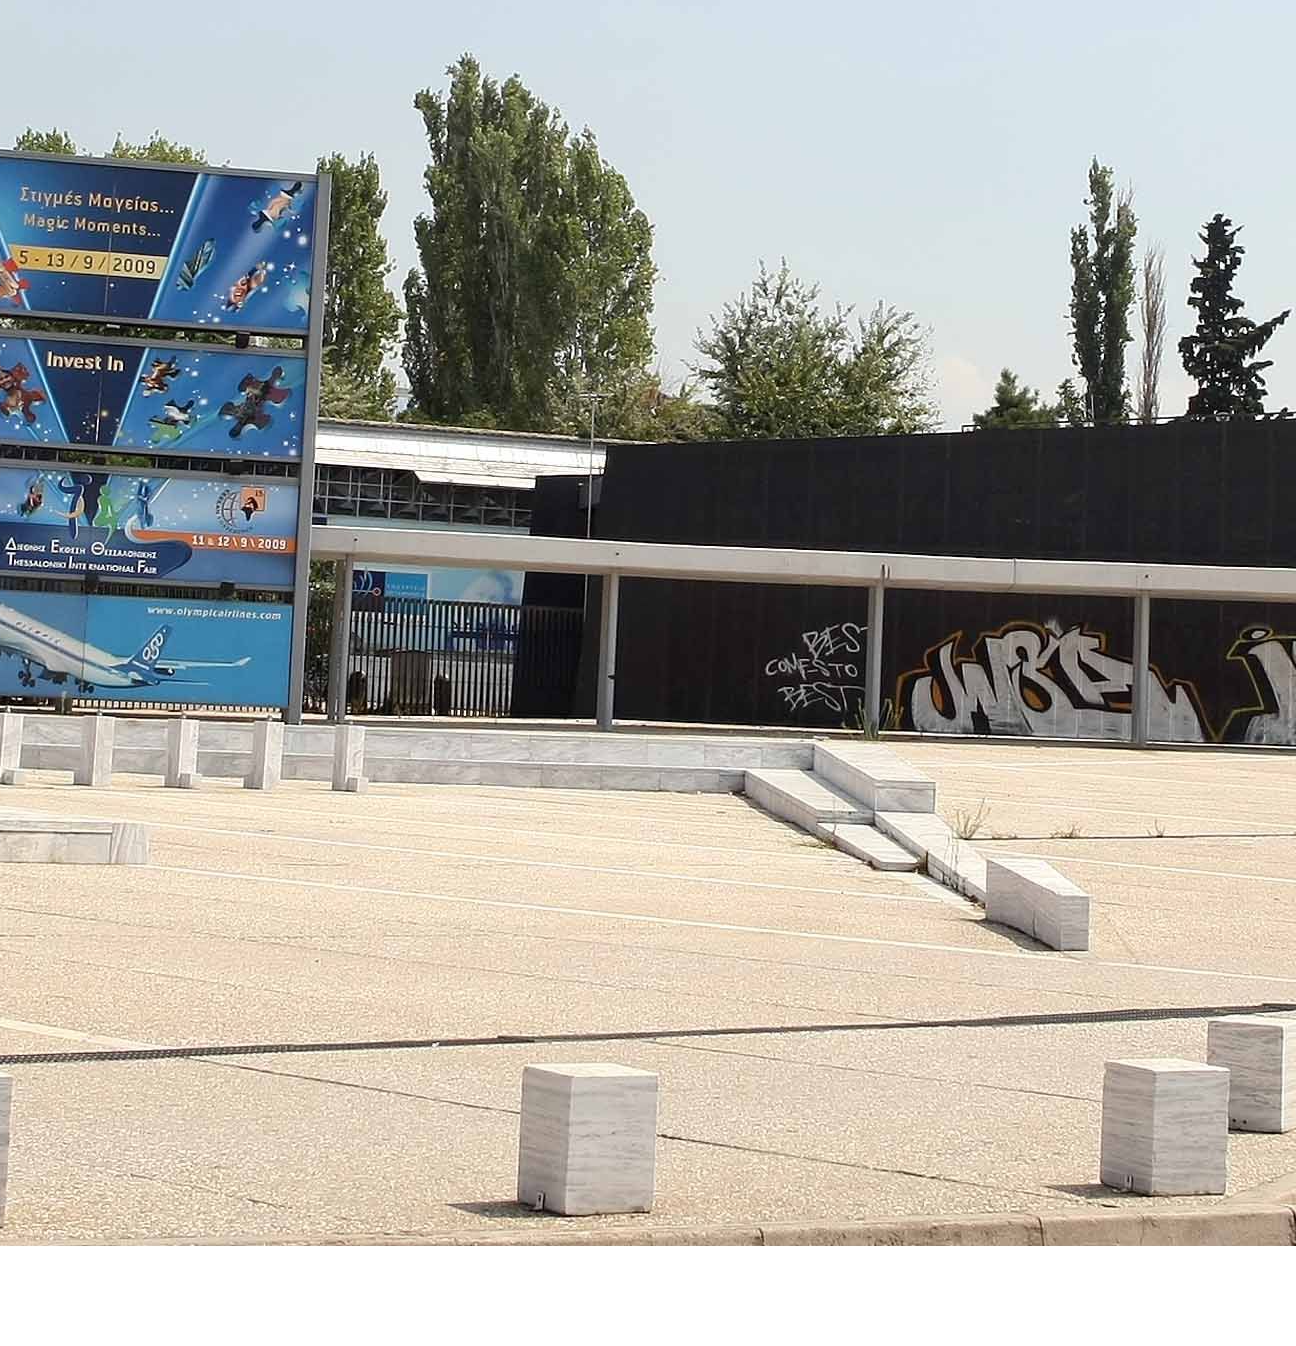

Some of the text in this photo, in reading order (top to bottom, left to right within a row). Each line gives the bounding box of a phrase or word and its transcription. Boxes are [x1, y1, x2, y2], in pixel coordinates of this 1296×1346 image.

[19, 185, 175, 215] Στιγμές Μαγείας...
[23, 213, 161, 237] Magic Moments...
[19, 250, 30, 265] 5
[47, 253, 65, 268] 13
[83, 254, 94, 270] 9
[112, 257, 157, 274] 2009
[46, 350, 124, 372] Invest In
[192, 535, 204, 545] 11
[258, 538, 286, 550] 2009
[147, 606, 281, 621] www.olympicairlines.com
